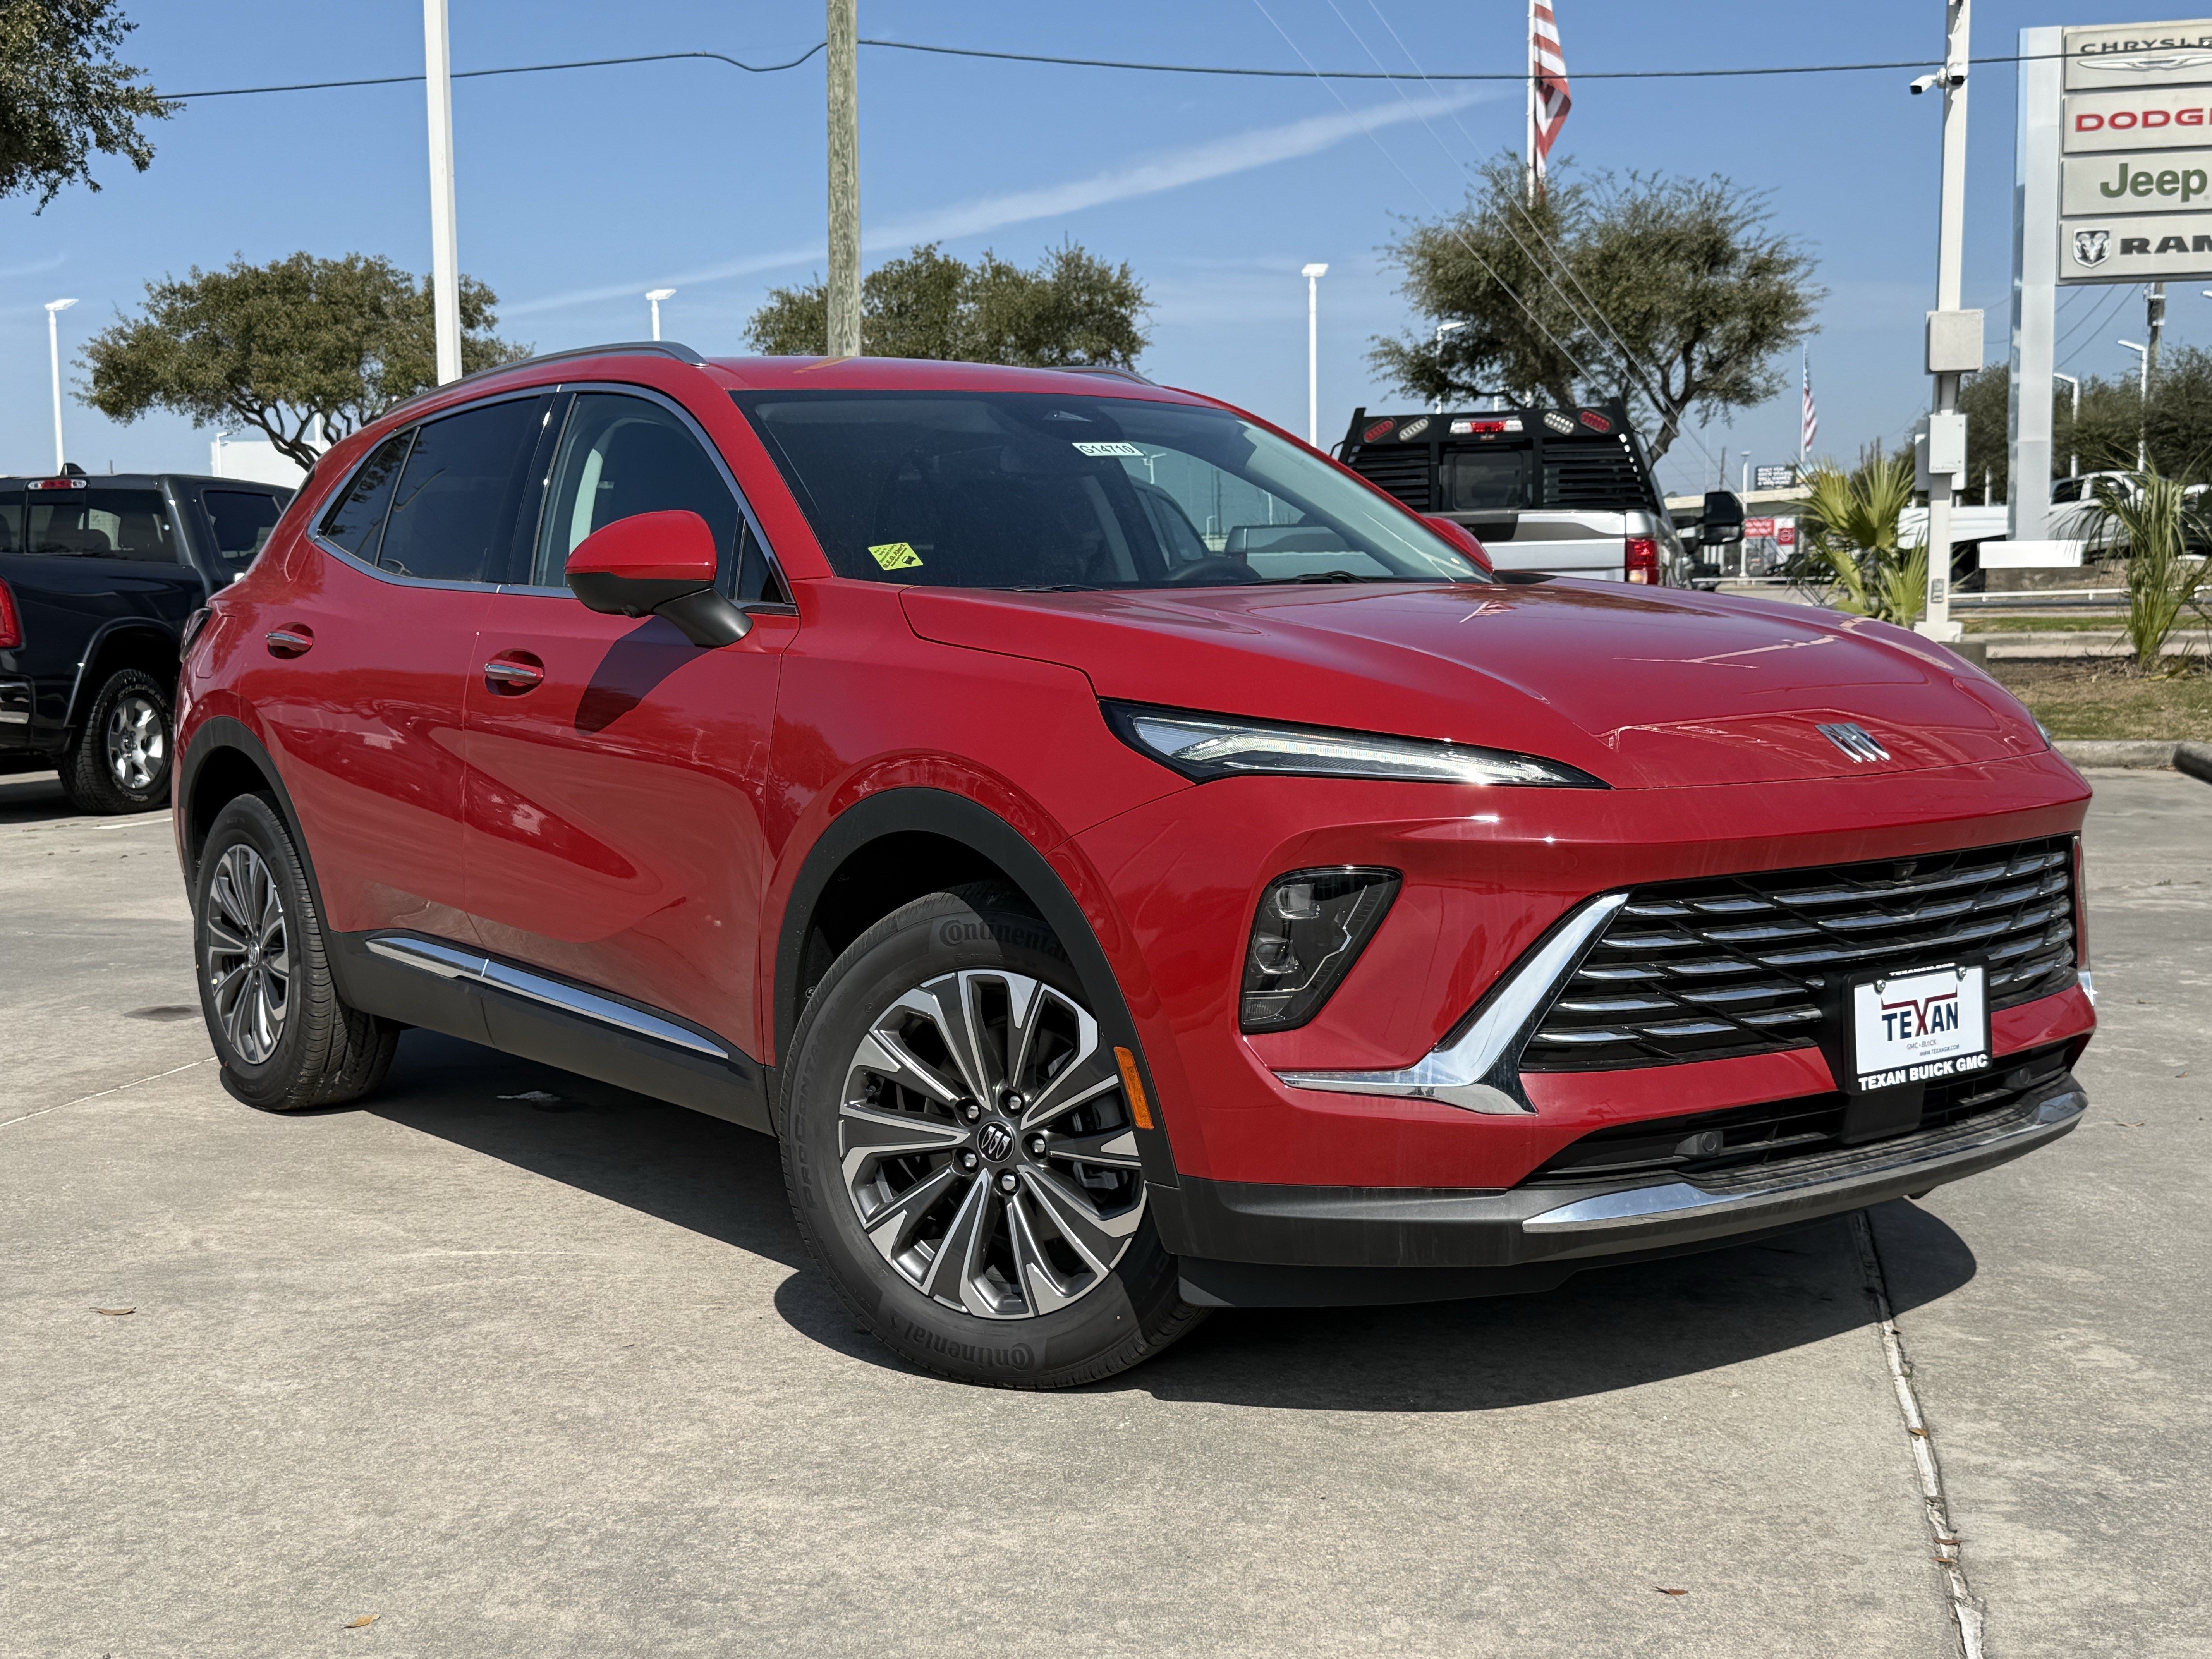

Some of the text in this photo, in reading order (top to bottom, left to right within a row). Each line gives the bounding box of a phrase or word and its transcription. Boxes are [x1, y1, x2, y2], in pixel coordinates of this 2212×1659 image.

[2075, 108, 2212, 132] DODG
[2100, 163, 2208, 203] Jeep
[1079, 445, 1135, 453] G14710
[1881, 993, 1959, 1042] TEXAN
[1858, 1053, 1989, 1091] TEXAN BUICK GMC
[904, 1323, 1036, 1372] Continental
